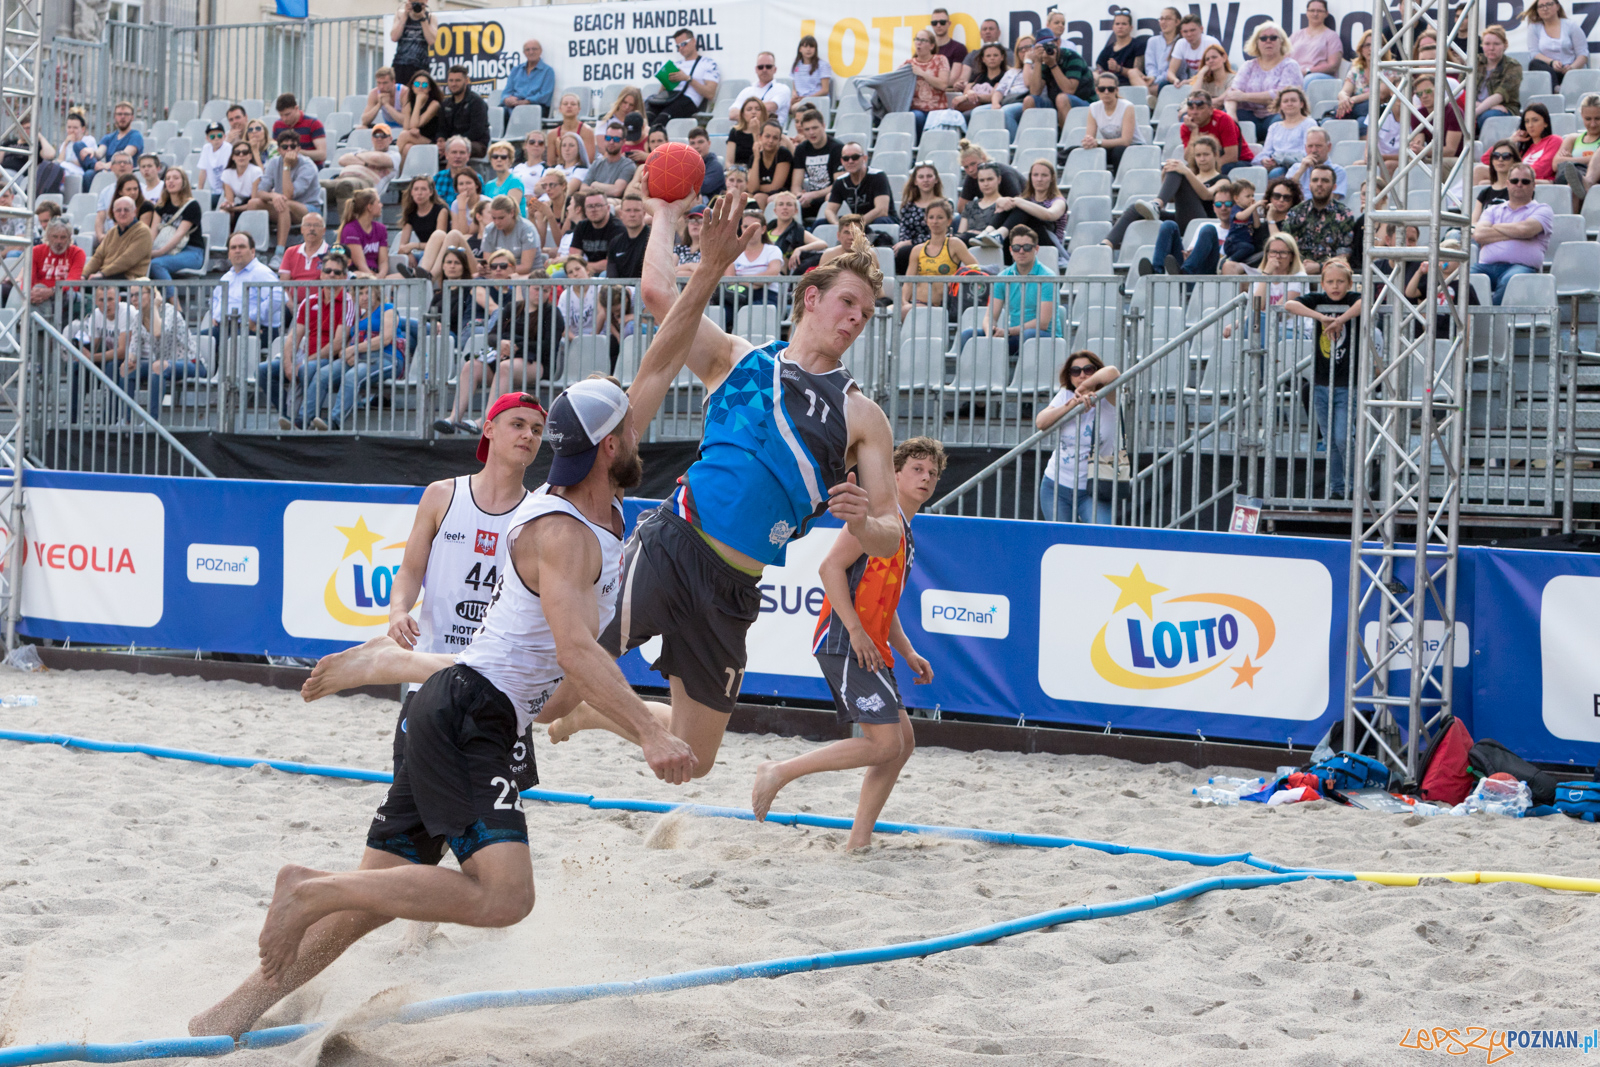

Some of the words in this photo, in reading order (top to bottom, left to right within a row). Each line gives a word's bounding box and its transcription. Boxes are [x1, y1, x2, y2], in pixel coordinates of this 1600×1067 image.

[574, 12, 625, 32] BEACH
[633, 8, 717, 29] HANDBALL
[568, 38, 618, 57] BEACH
[626, 33, 723, 54] VOLLEALL
[583, 62, 634, 81] BEACH
[34, 541, 136, 574] VEOLIA
[465, 561, 497, 593] 44
[459, 602, 488, 620] JUK
[758, 584, 826, 617] sue
[1127, 613, 1239, 669] LOTTO
